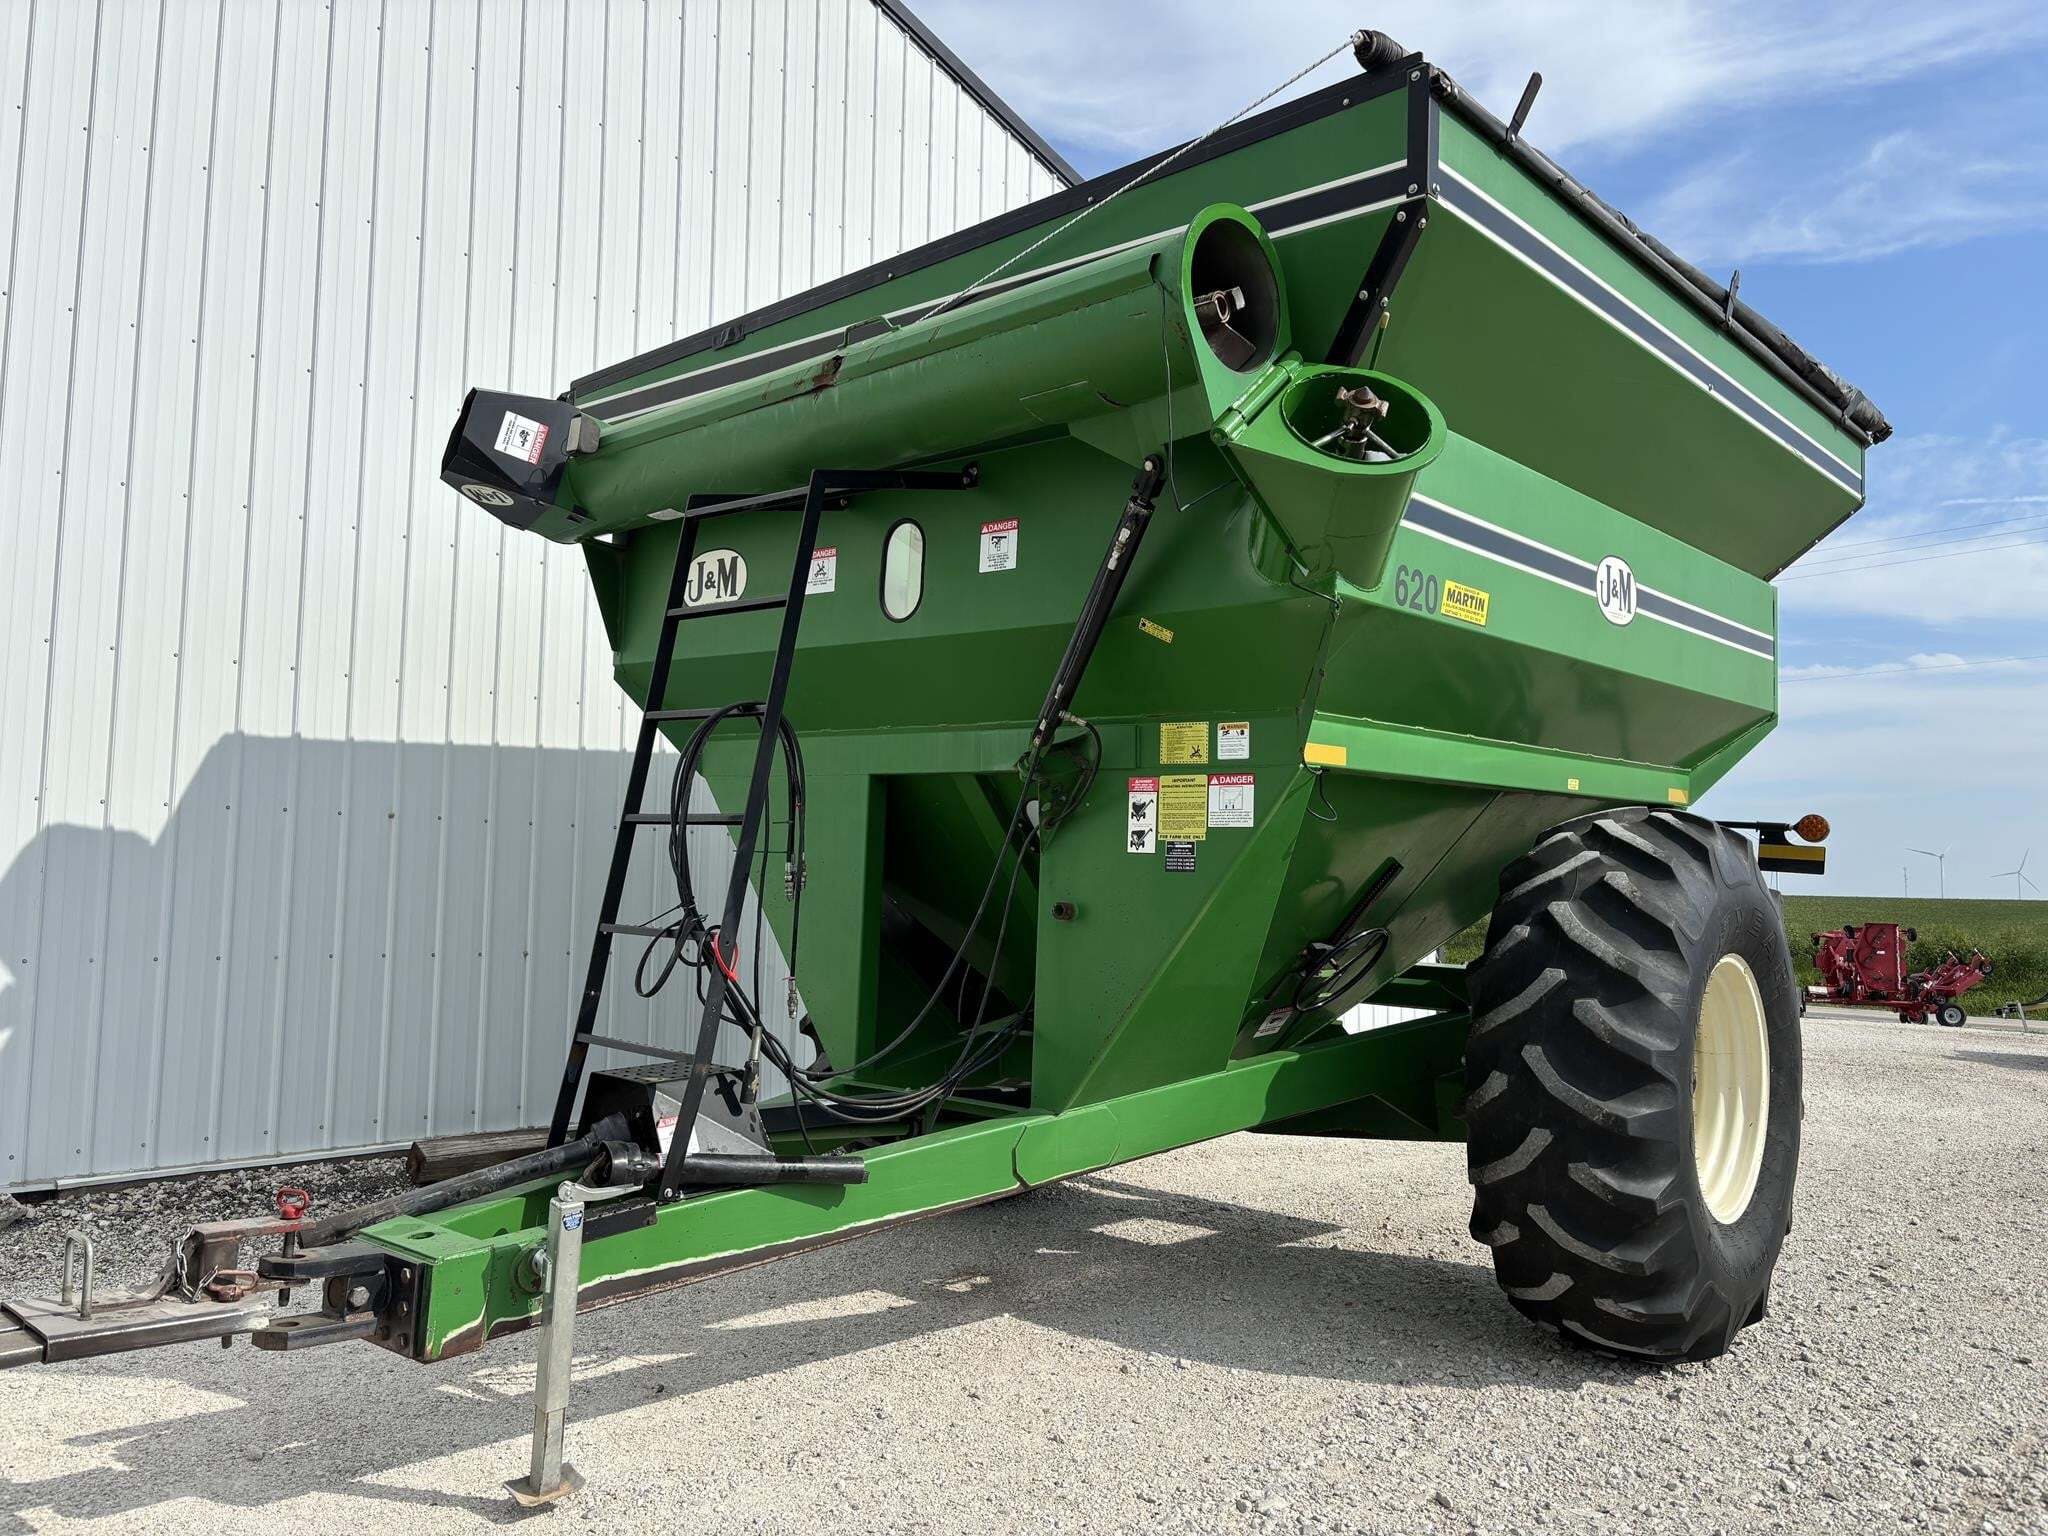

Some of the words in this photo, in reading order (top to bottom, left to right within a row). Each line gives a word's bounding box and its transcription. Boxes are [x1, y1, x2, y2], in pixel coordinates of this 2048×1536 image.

[529, 430, 546, 464] DANGER
[988, 520, 1018, 532] DANGER
[812, 549, 837, 559] DANGER
[687, 555, 739, 602] J&M
[1395, 564, 1438, 615] 620
[1600, 564, 1632, 614] J&M
[1446, 587, 1485, 613] MARTIN
[1219, 775, 1254, 784] DANGER
